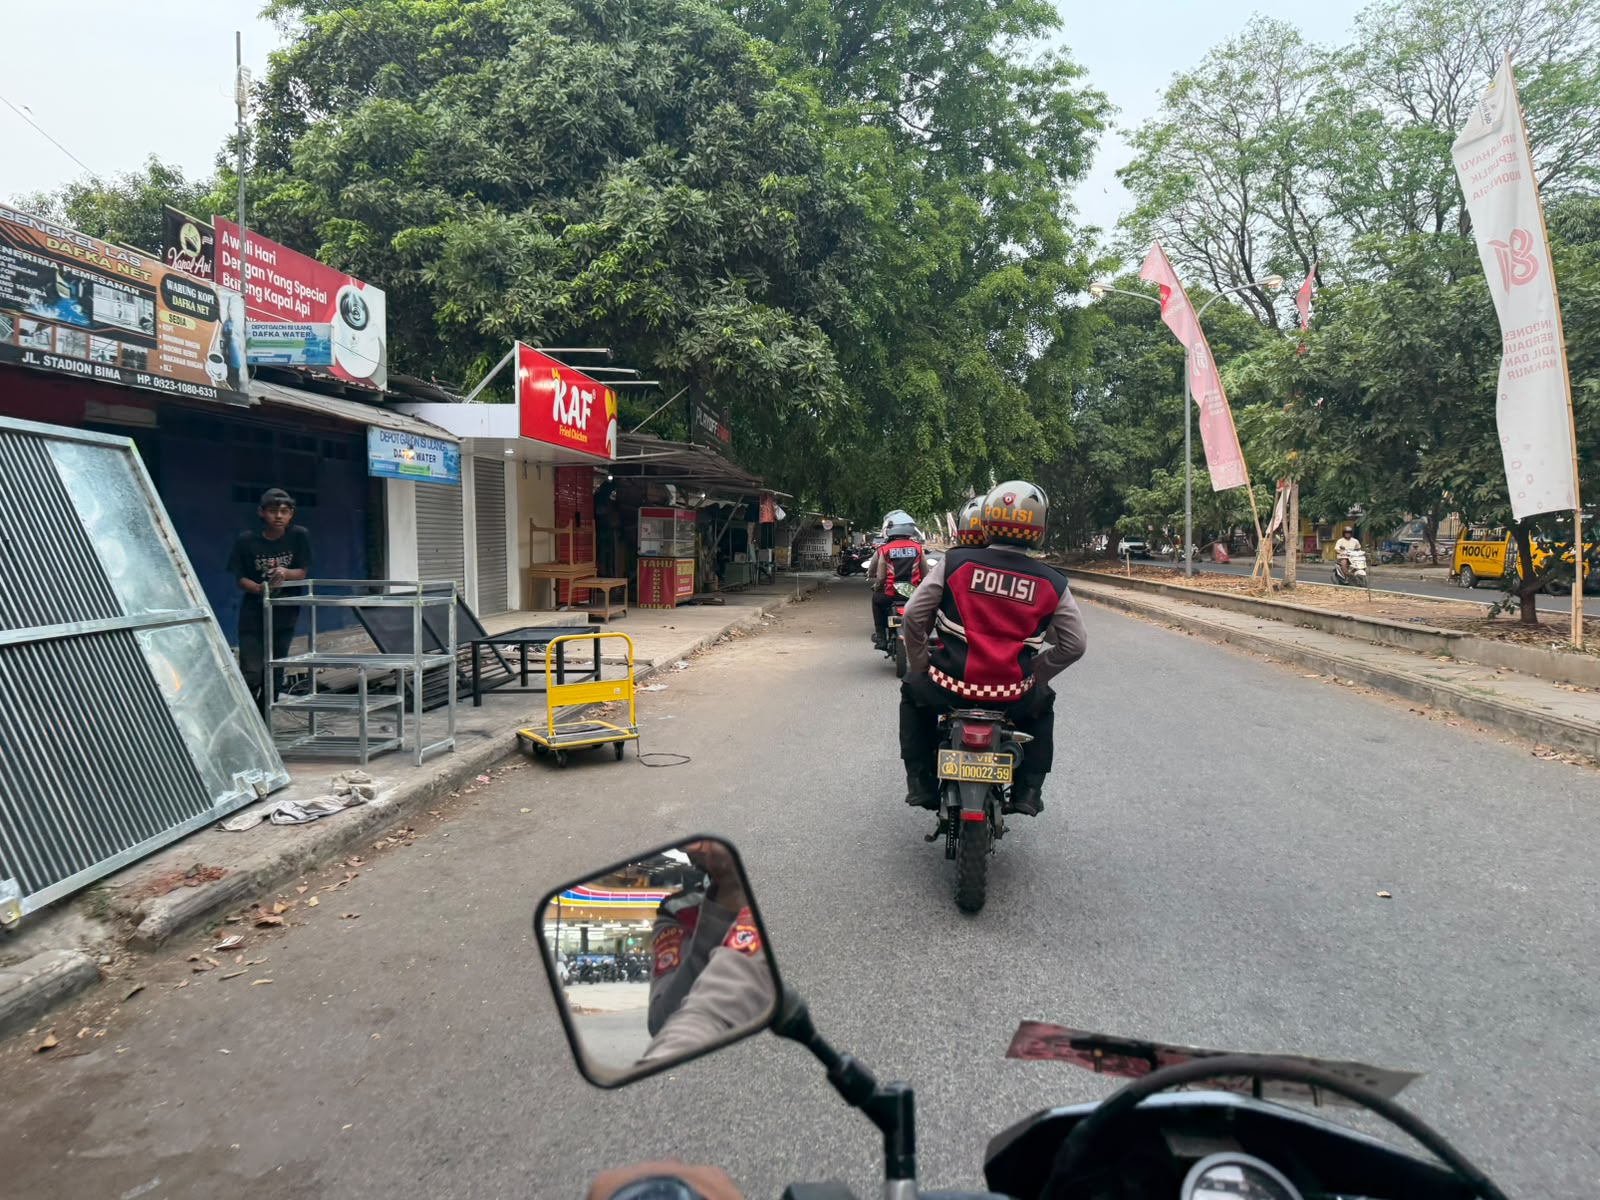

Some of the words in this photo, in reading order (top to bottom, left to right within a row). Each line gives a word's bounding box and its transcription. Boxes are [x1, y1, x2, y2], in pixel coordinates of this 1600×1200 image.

[105, 247, 141, 267] LAS
[222, 230, 253, 256] Awli
[254, 244, 277, 266] Hari
[46, 237, 112, 269] DAFKA
[117, 262, 151, 281] NET
[167, 247, 196, 274] Kapal
[194, 255, 212, 278] Api
[63, 265, 139, 296] PEMESANAN
[267, 268, 293, 295] Yang
[294, 279, 328, 305] Special
[166, 279, 197, 298] WARUNG
[198, 291, 214, 304] KOPI
[172, 295, 195, 312] DAFKA
[197, 304, 210, 316] NET
[264, 287, 294, 310] Kapal
[295, 299, 310, 318] Api
[168, 313, 187, 326] SEDIA
[21, 351, 40, 365] JL.
[43, 354, 92, 375] STADION
[94, 364, 121, 381] BIMA
[137, 373, 151, 386] HP.
[552, 378, 593, 431] KAF
[380, 431, 399, 444] DEPOT
[399, 433, 420, 448] GALON
[427, 439, 447, 452] ULANG
[559, 424, 572, 438] Fried
[571, 429, 588, 443] Chicken
[416, 452, 437, 463] WATER
[985, 505, 1034, 524] POLISI
[890, 547, 916, 558] POLISI
[1462, 545, 1499, 558] MOOCOW
[643, 560, 673, 568] TAHU
[969, 568, 1036, 602] POLISI
